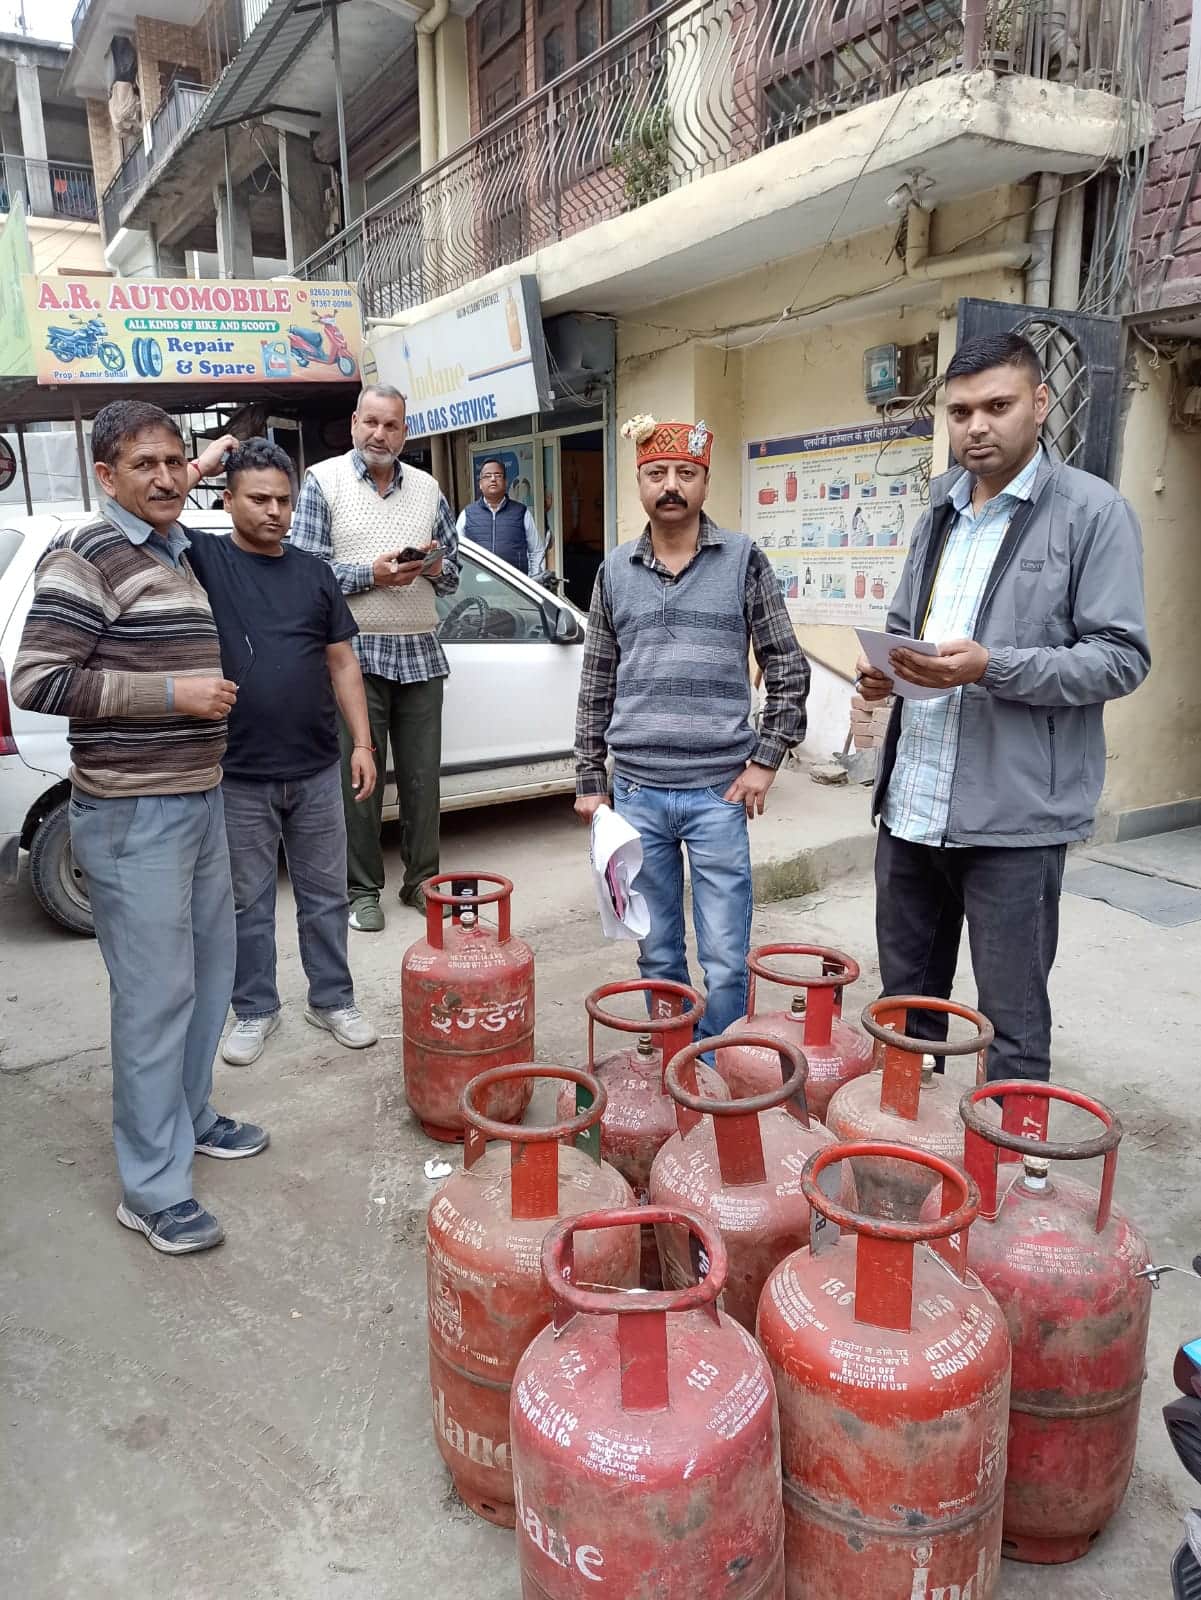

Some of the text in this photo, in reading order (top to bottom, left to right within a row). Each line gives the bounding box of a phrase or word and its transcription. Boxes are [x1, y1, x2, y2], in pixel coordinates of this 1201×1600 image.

[38, 282, 292, 313] A.R. AUTOMOBILE
[128, 319, 277, 331] ALL KINDS OF BIKE AND SCOOTY
[166, 337, 234, 355] Repair
[176, 359, 256, 377] & Spare
[427, 406, 449, 431] GAS
[449, 393, 498, 427] SERVICE
[819, 1277, 857, 1306] 15.6
[918, 1294, 956, 1322] 15.6
[686, 1359, 720, 1391] 15.5
[841, 1367, 896, 1383] REGULATOR
[879, 1366, 897, 1375] OFF
[930, 1351, 969, 1380] GROSS
[829, 1372, 855, 1386] WHEN
[877, 1382, 888, 1391] IN
[889, 1382, 909, 1391] USE
